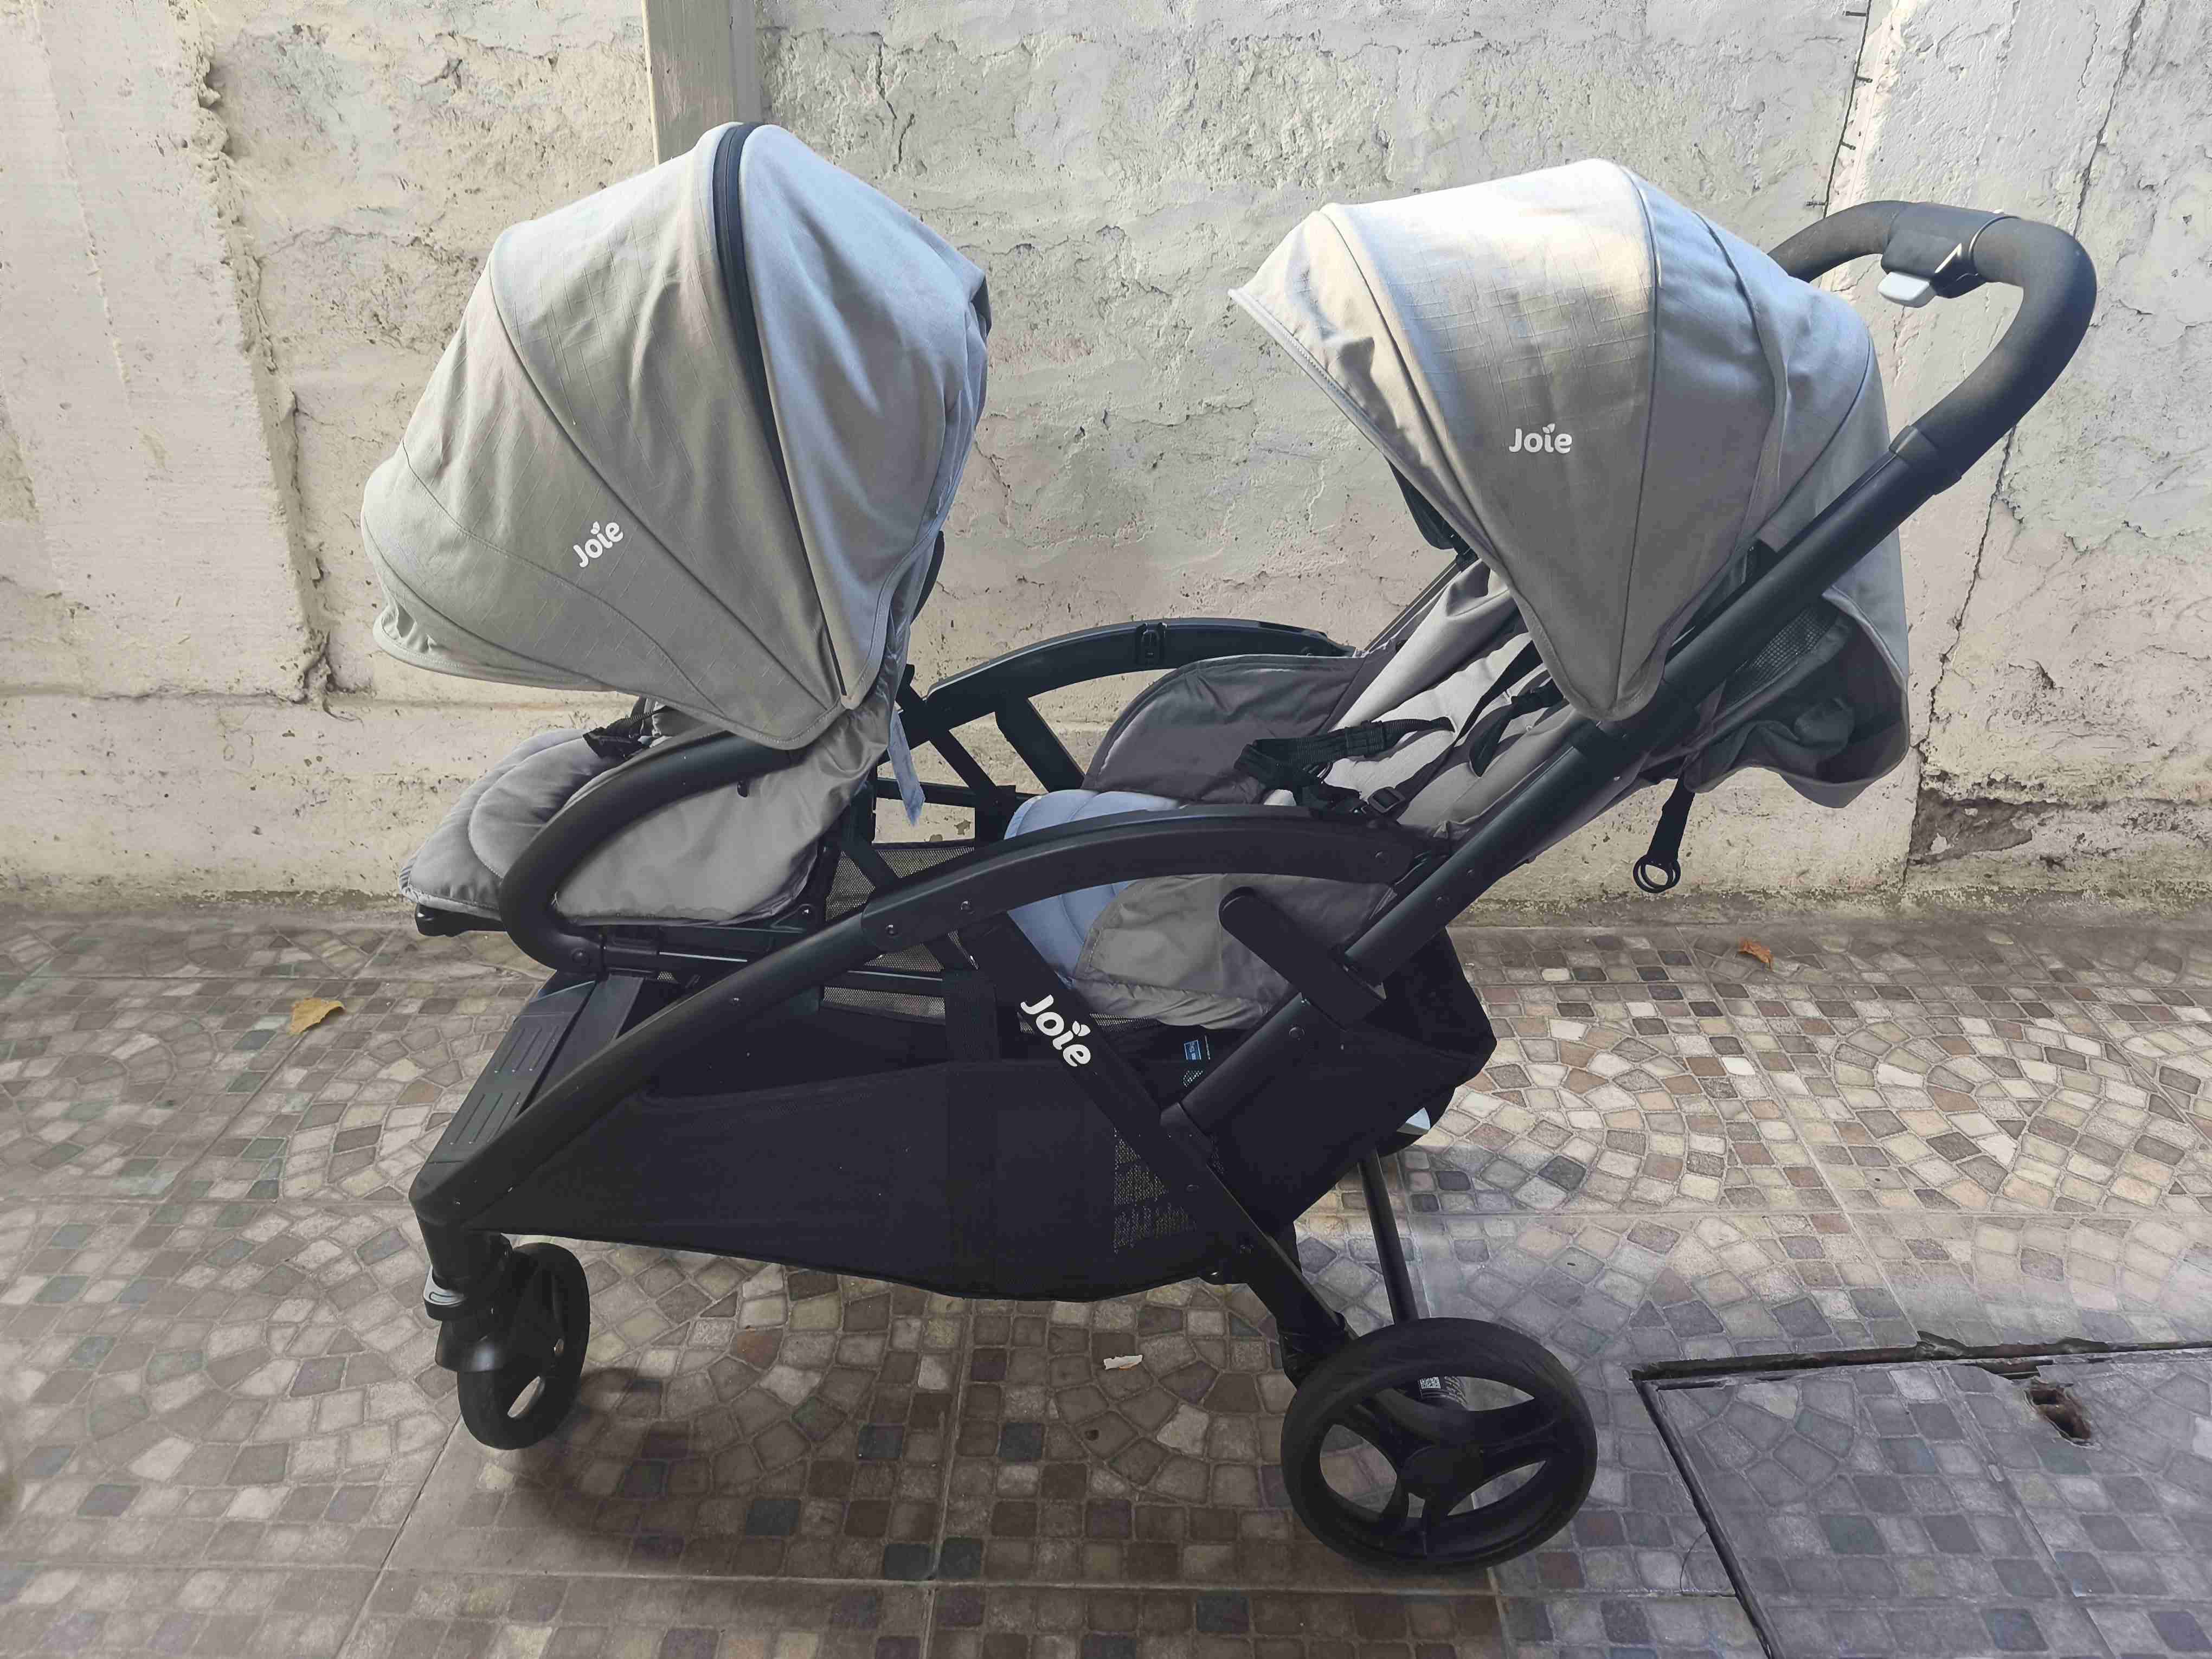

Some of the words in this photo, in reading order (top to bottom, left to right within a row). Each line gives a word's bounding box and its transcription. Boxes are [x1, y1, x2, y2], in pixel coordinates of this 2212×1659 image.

[1509, 423, 1572, 454] Joie
[573, 521, 623, 568] Joie
[1020, 994, 1091, 1067] Joie
